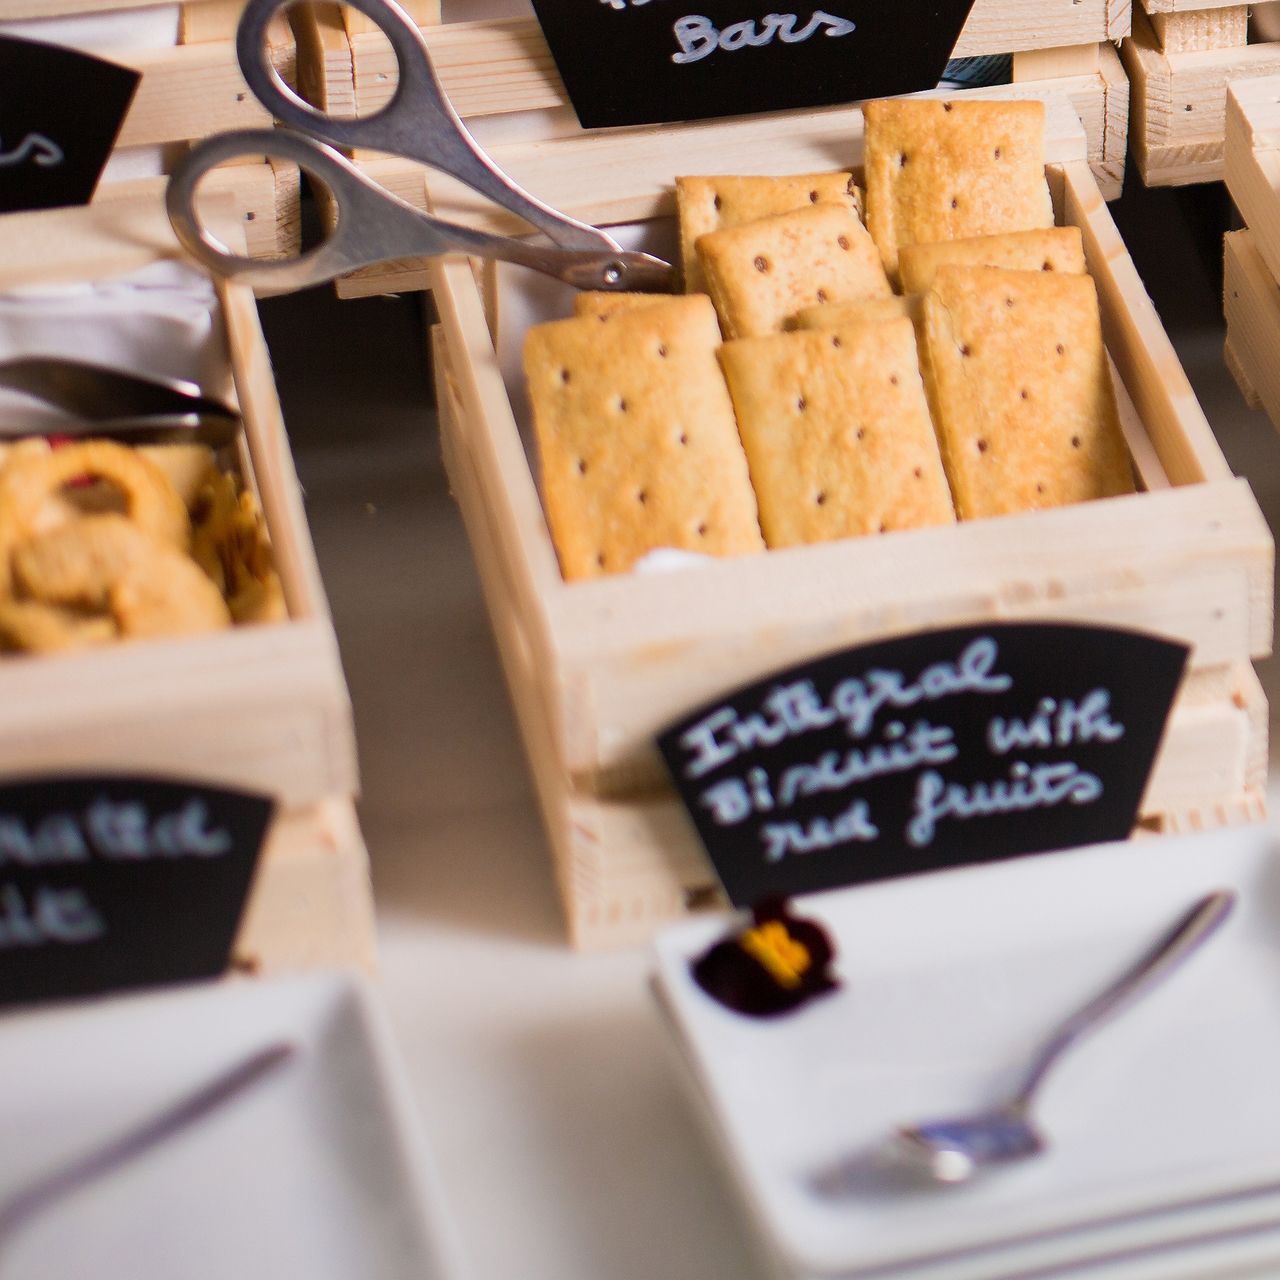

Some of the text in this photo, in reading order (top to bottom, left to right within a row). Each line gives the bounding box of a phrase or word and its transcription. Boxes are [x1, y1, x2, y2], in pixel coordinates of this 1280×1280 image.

[671, 10, 856, 64] Bars
[683, 638, 1012, 776] Integral
[988, 687, 1125, 752] with
[908, 762, 1102, 845] fruits
